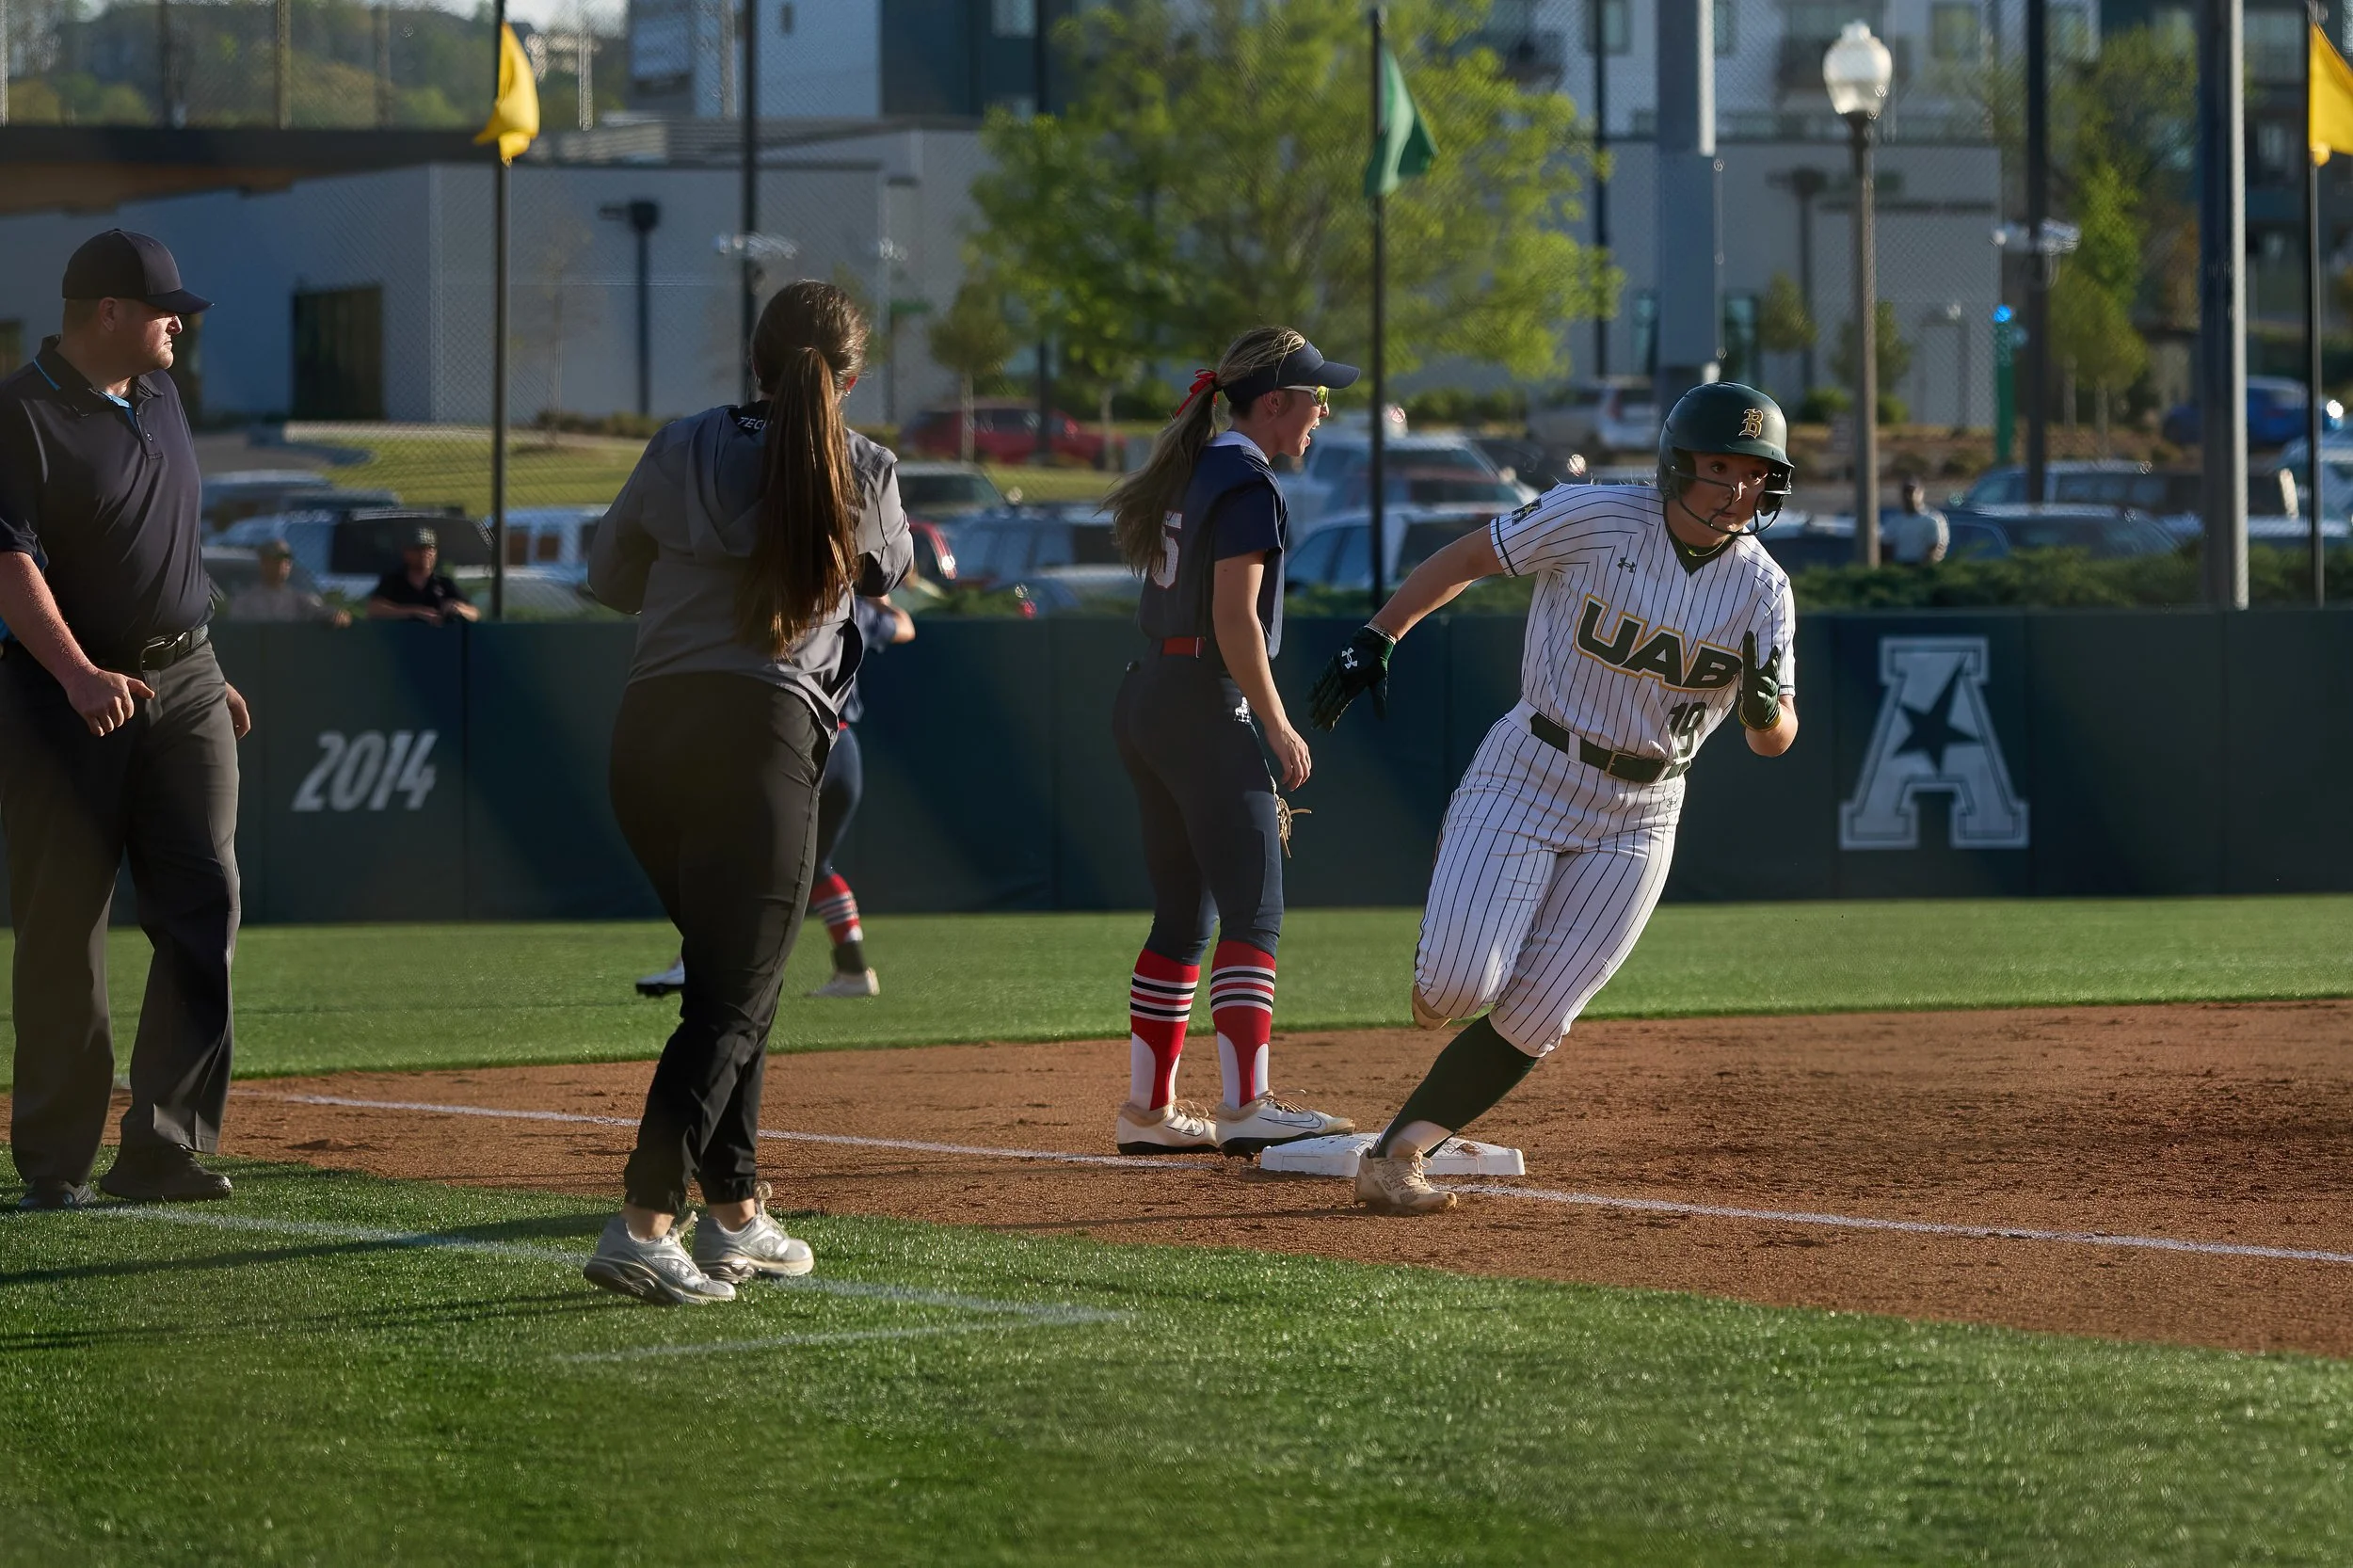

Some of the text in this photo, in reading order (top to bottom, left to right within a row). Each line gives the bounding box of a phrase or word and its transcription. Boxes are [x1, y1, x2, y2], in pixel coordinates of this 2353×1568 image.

[1738, 408, 1764, 440] B
[1574, 593, 1743, 693] UAB
[291, 729, 440, 812] 2014
[1666, 702, 1707, 759] 10
[1839, 636, 2030, 850] A
